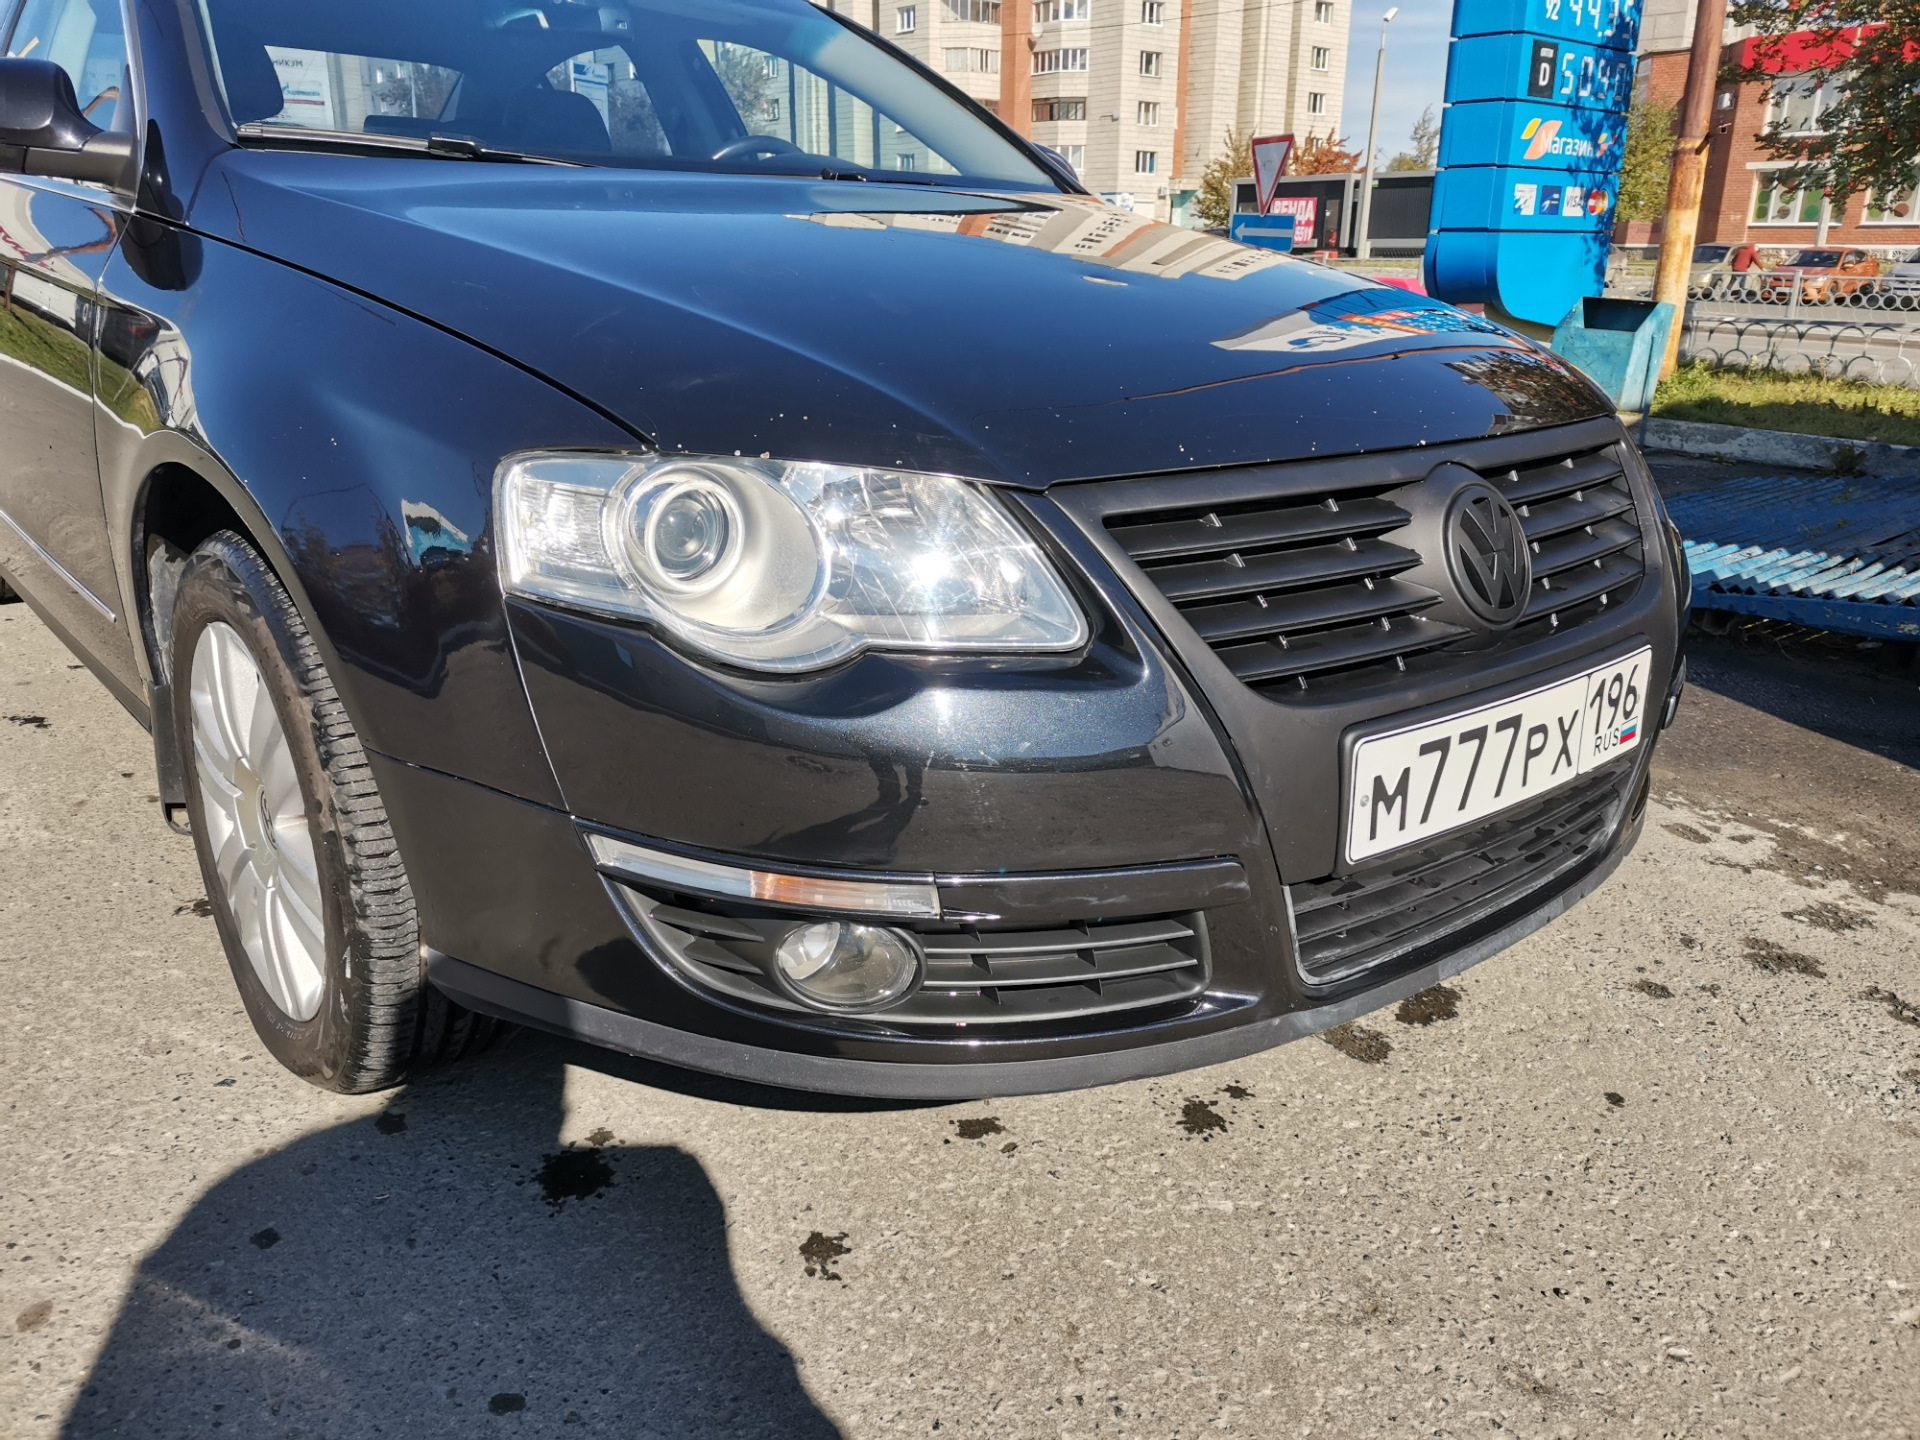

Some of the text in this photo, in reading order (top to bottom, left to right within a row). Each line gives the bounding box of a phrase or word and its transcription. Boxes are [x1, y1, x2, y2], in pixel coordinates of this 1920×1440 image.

[1545, 0, 1561, 21] 92
[1538, 62, 1550, 87] D
[1539, 128, 1595, 157] Магазин
[1566, 194, 1584, 208] VISA
[1369, 663, 1639, 842] М777РХ 196
[1593, 725, 1620, 757] RUS
